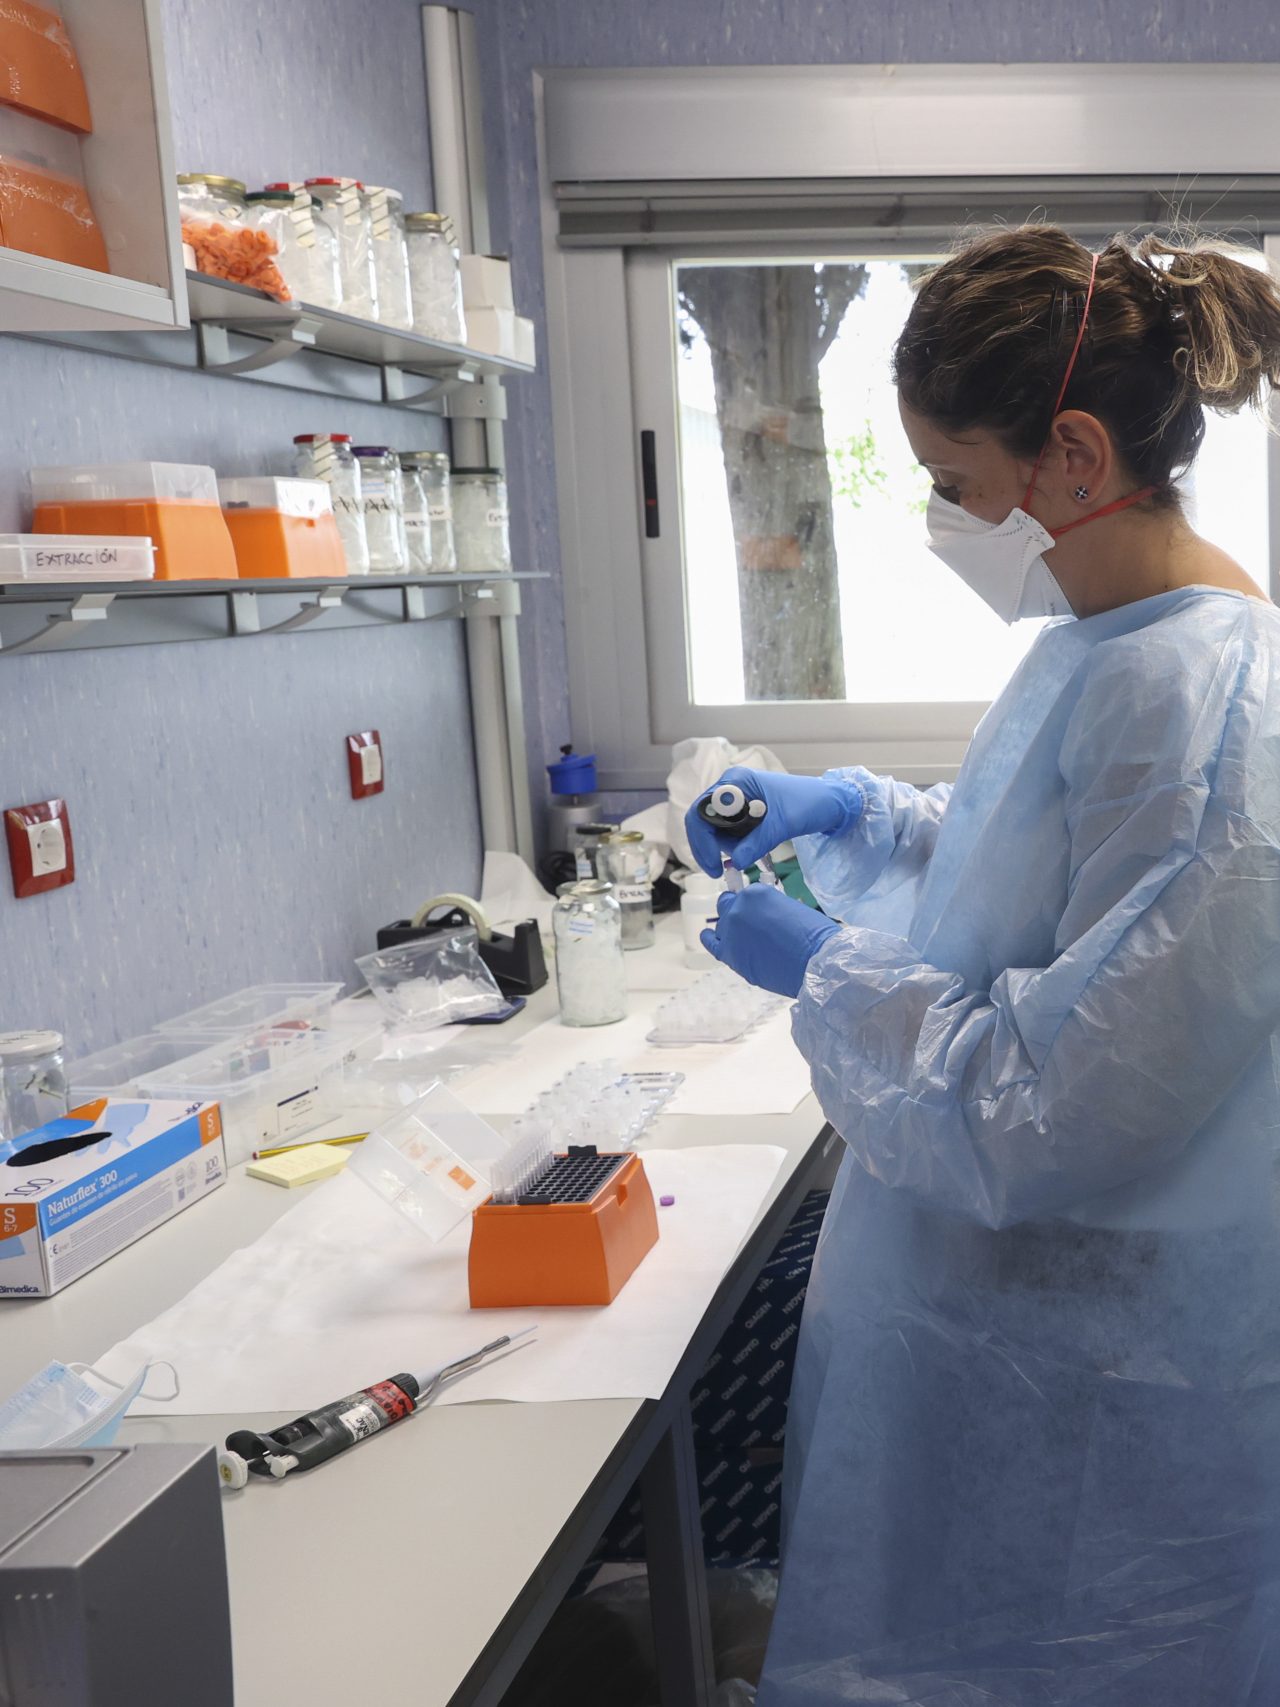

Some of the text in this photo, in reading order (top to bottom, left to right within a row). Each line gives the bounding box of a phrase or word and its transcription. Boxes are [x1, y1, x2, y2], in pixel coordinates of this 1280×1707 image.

[35, 548, 118, 567] EXTRACCIÓN
[207, 1113, 214, 1129] S
[5, 1178, 54, 1197] 100
[100, 1169, 118, 1189] 300
[4, 1207, 16, 1224] S
[4, 1224, 18, 1233] 6-7
